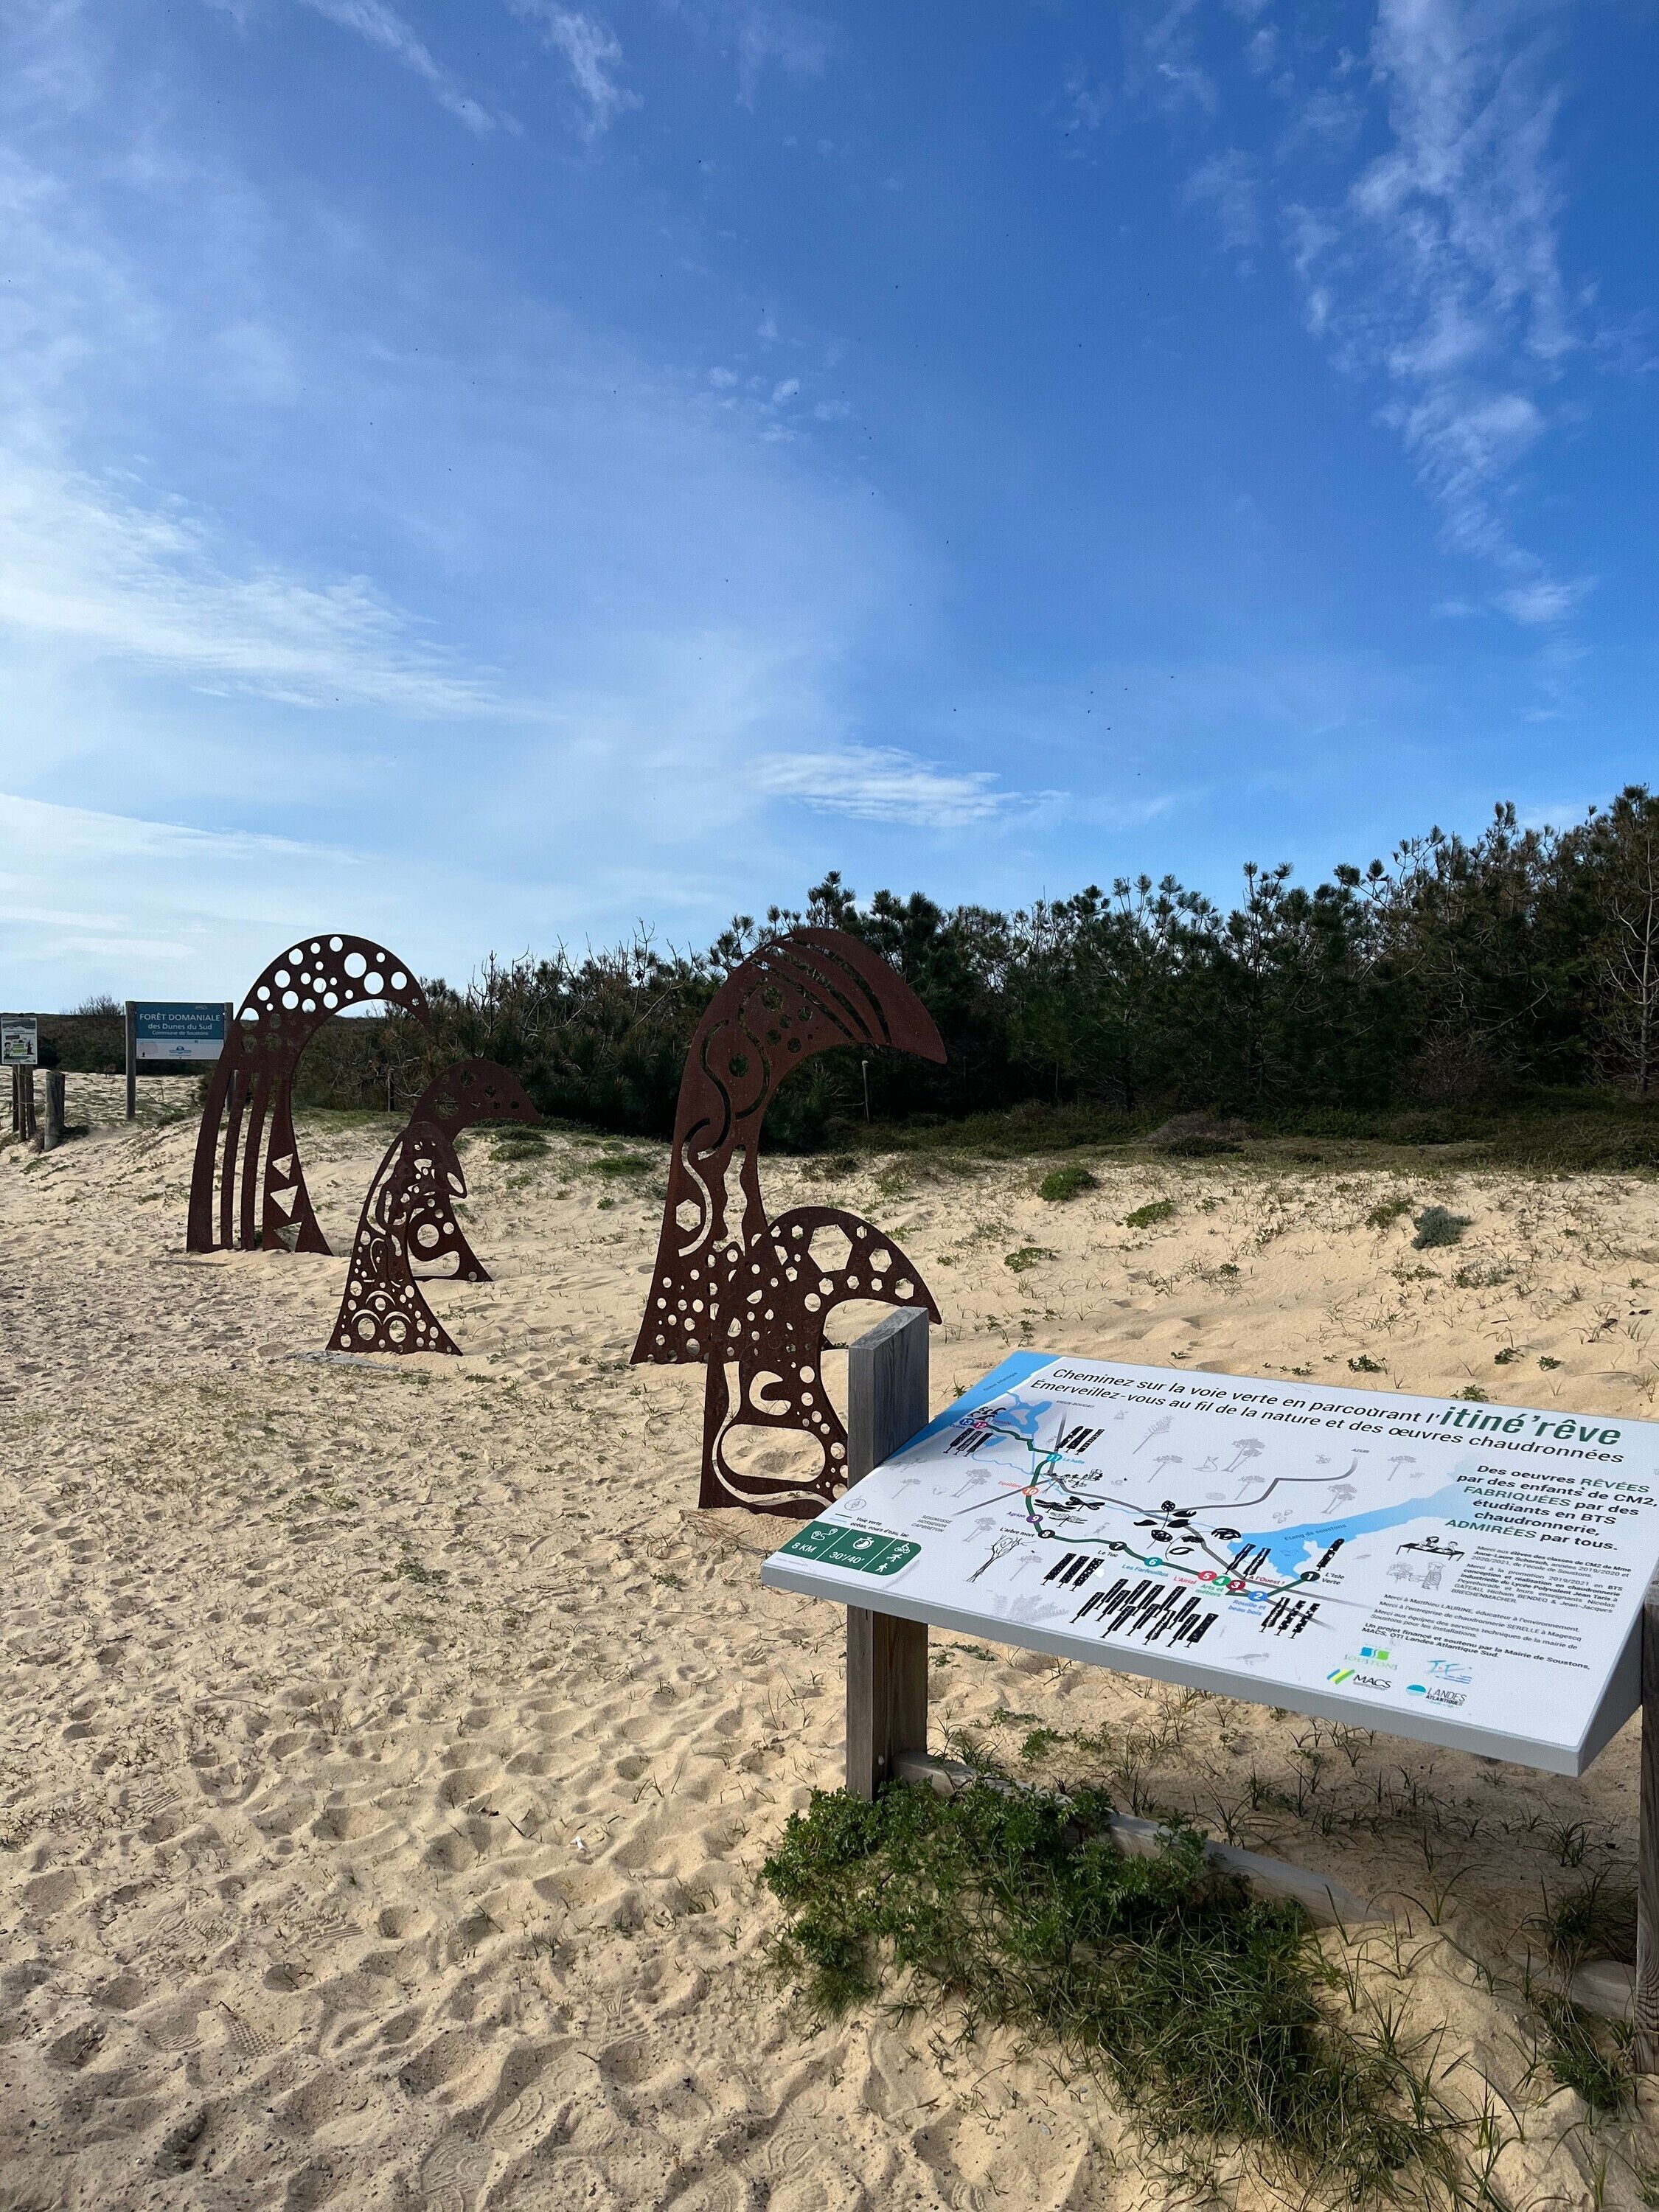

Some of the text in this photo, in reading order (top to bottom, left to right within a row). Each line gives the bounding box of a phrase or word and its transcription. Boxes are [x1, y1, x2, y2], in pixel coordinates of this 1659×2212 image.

[139, 1012, 220, 1022] FORÊT DOMANIALE
[1053, 1368, 1135, 1387] Cheminez
[1136, 1381, 1167, 1391] sur
[1168, 1382, 1186, 1394] la
[1191, 1388, 1227, 1398] voie
[1232, 1393, 1279, 1405] verte
[1282, 1399, 1306, 1408] en
[1308, 1402, 1422, 1422] parcourant
[1030, 1378, 1166, 1405] Émerveillez-vous
[1168, 1400, 1192, 1408] au
[1194, 1401, 1214, 1411] fil
[1215, 1404, 1237, 1414] de
[1240, 1407, 1258, 1417] la
[1261, 1412, 1321, 1425] nature
[1325, 1419, 1345, 1429] et
[1349, 1421, 1384, 1433] des
[1388, 1427, 1464, 1443] œuvres
[1469, 1436, 1624, 1463] chaudronnées
[1456, 1475, 1657, 1507] par des enfants de CM2,
[1477, 1465, 1650, 1493] Des oeuvres RÊVÉES
[1464, 1486, 1639, 1515] FABRIQUÉES par des
[1472, 1499, 1617, 1524] étudiants en BTS
[999, 1526, 1035, 1538] L'arbre mort
[1444, 1519, 1618, 1550] ADMIRÉES par tous.
[1474, 1512, 1600, 1536] chaudronnerie,
[791, 1542, 818, 1553] 8 KM
[1306, 1572, 1315, 1580] 1
[1321, 1578, 1341, 1586] Verte
[1228, 1605, 1263, 1616] beau bois
[1232, 1599, 1258, 1608] Rouille
[1361, 1627, 1387, 1637] MACS,
[1405, 1636, 1435, 1645] Landes
[1435, 1642, 1479, 1654] Atlantique
[1377, 1626, 1401, 1635] projet
[1400, 1630, 1432, 1640] financé
[1443, 1638, 1478, 1648] soutenu
[1504, 1649, 1531, 1658] Mairie
[1353, 1674, 1393, 1689] MACS
[1427, 1688, 1467, 1703] LANDES
